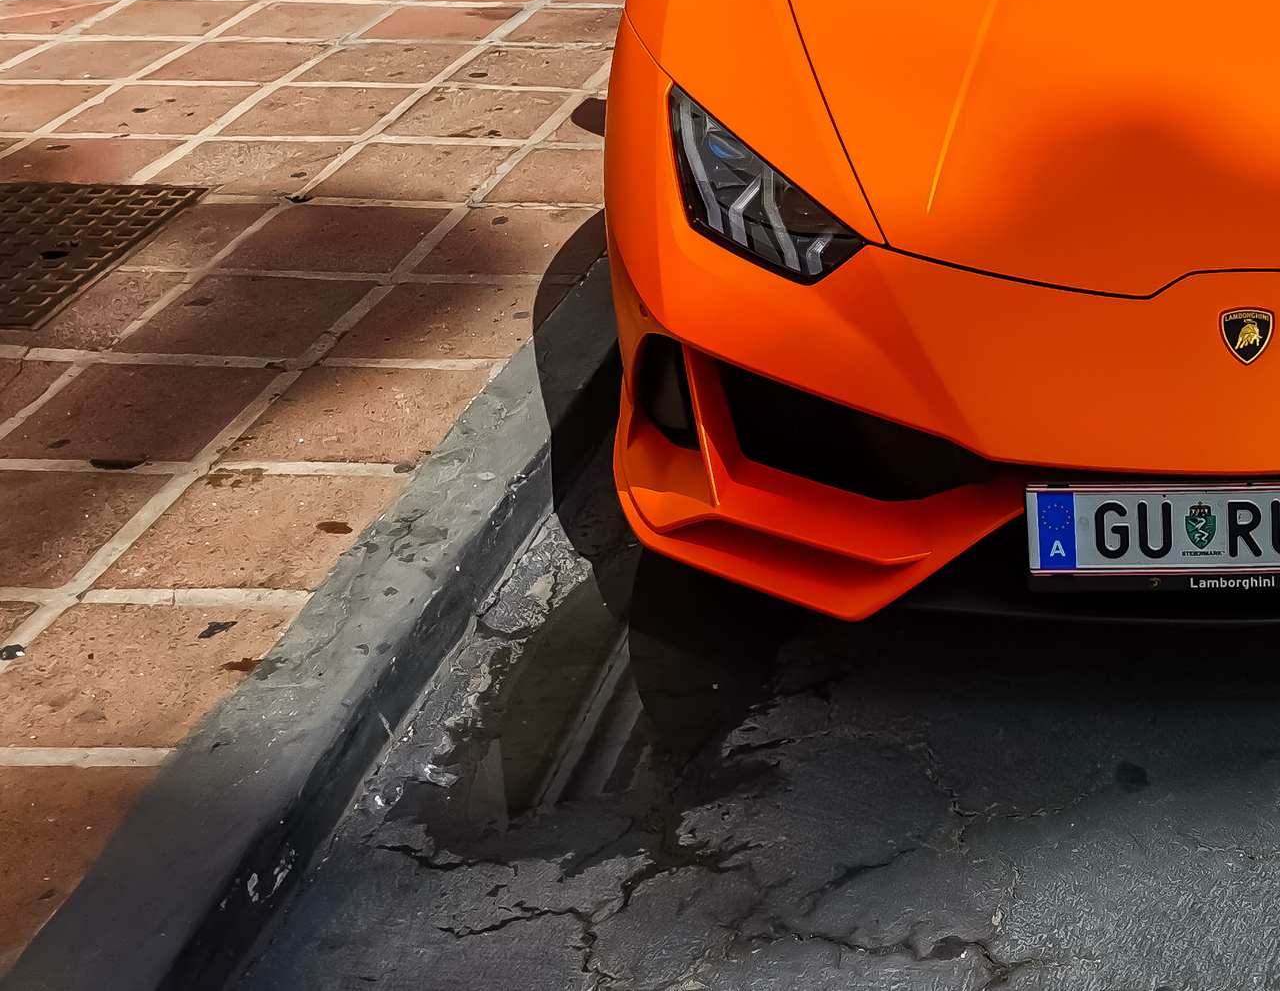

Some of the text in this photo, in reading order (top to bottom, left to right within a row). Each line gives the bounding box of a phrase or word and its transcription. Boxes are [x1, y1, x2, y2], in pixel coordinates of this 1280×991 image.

[1094, 499, 1173, 560] GU
[1050, 540, 1066, 557] A
[1190, 576, 1275, 590] Lamborghini
